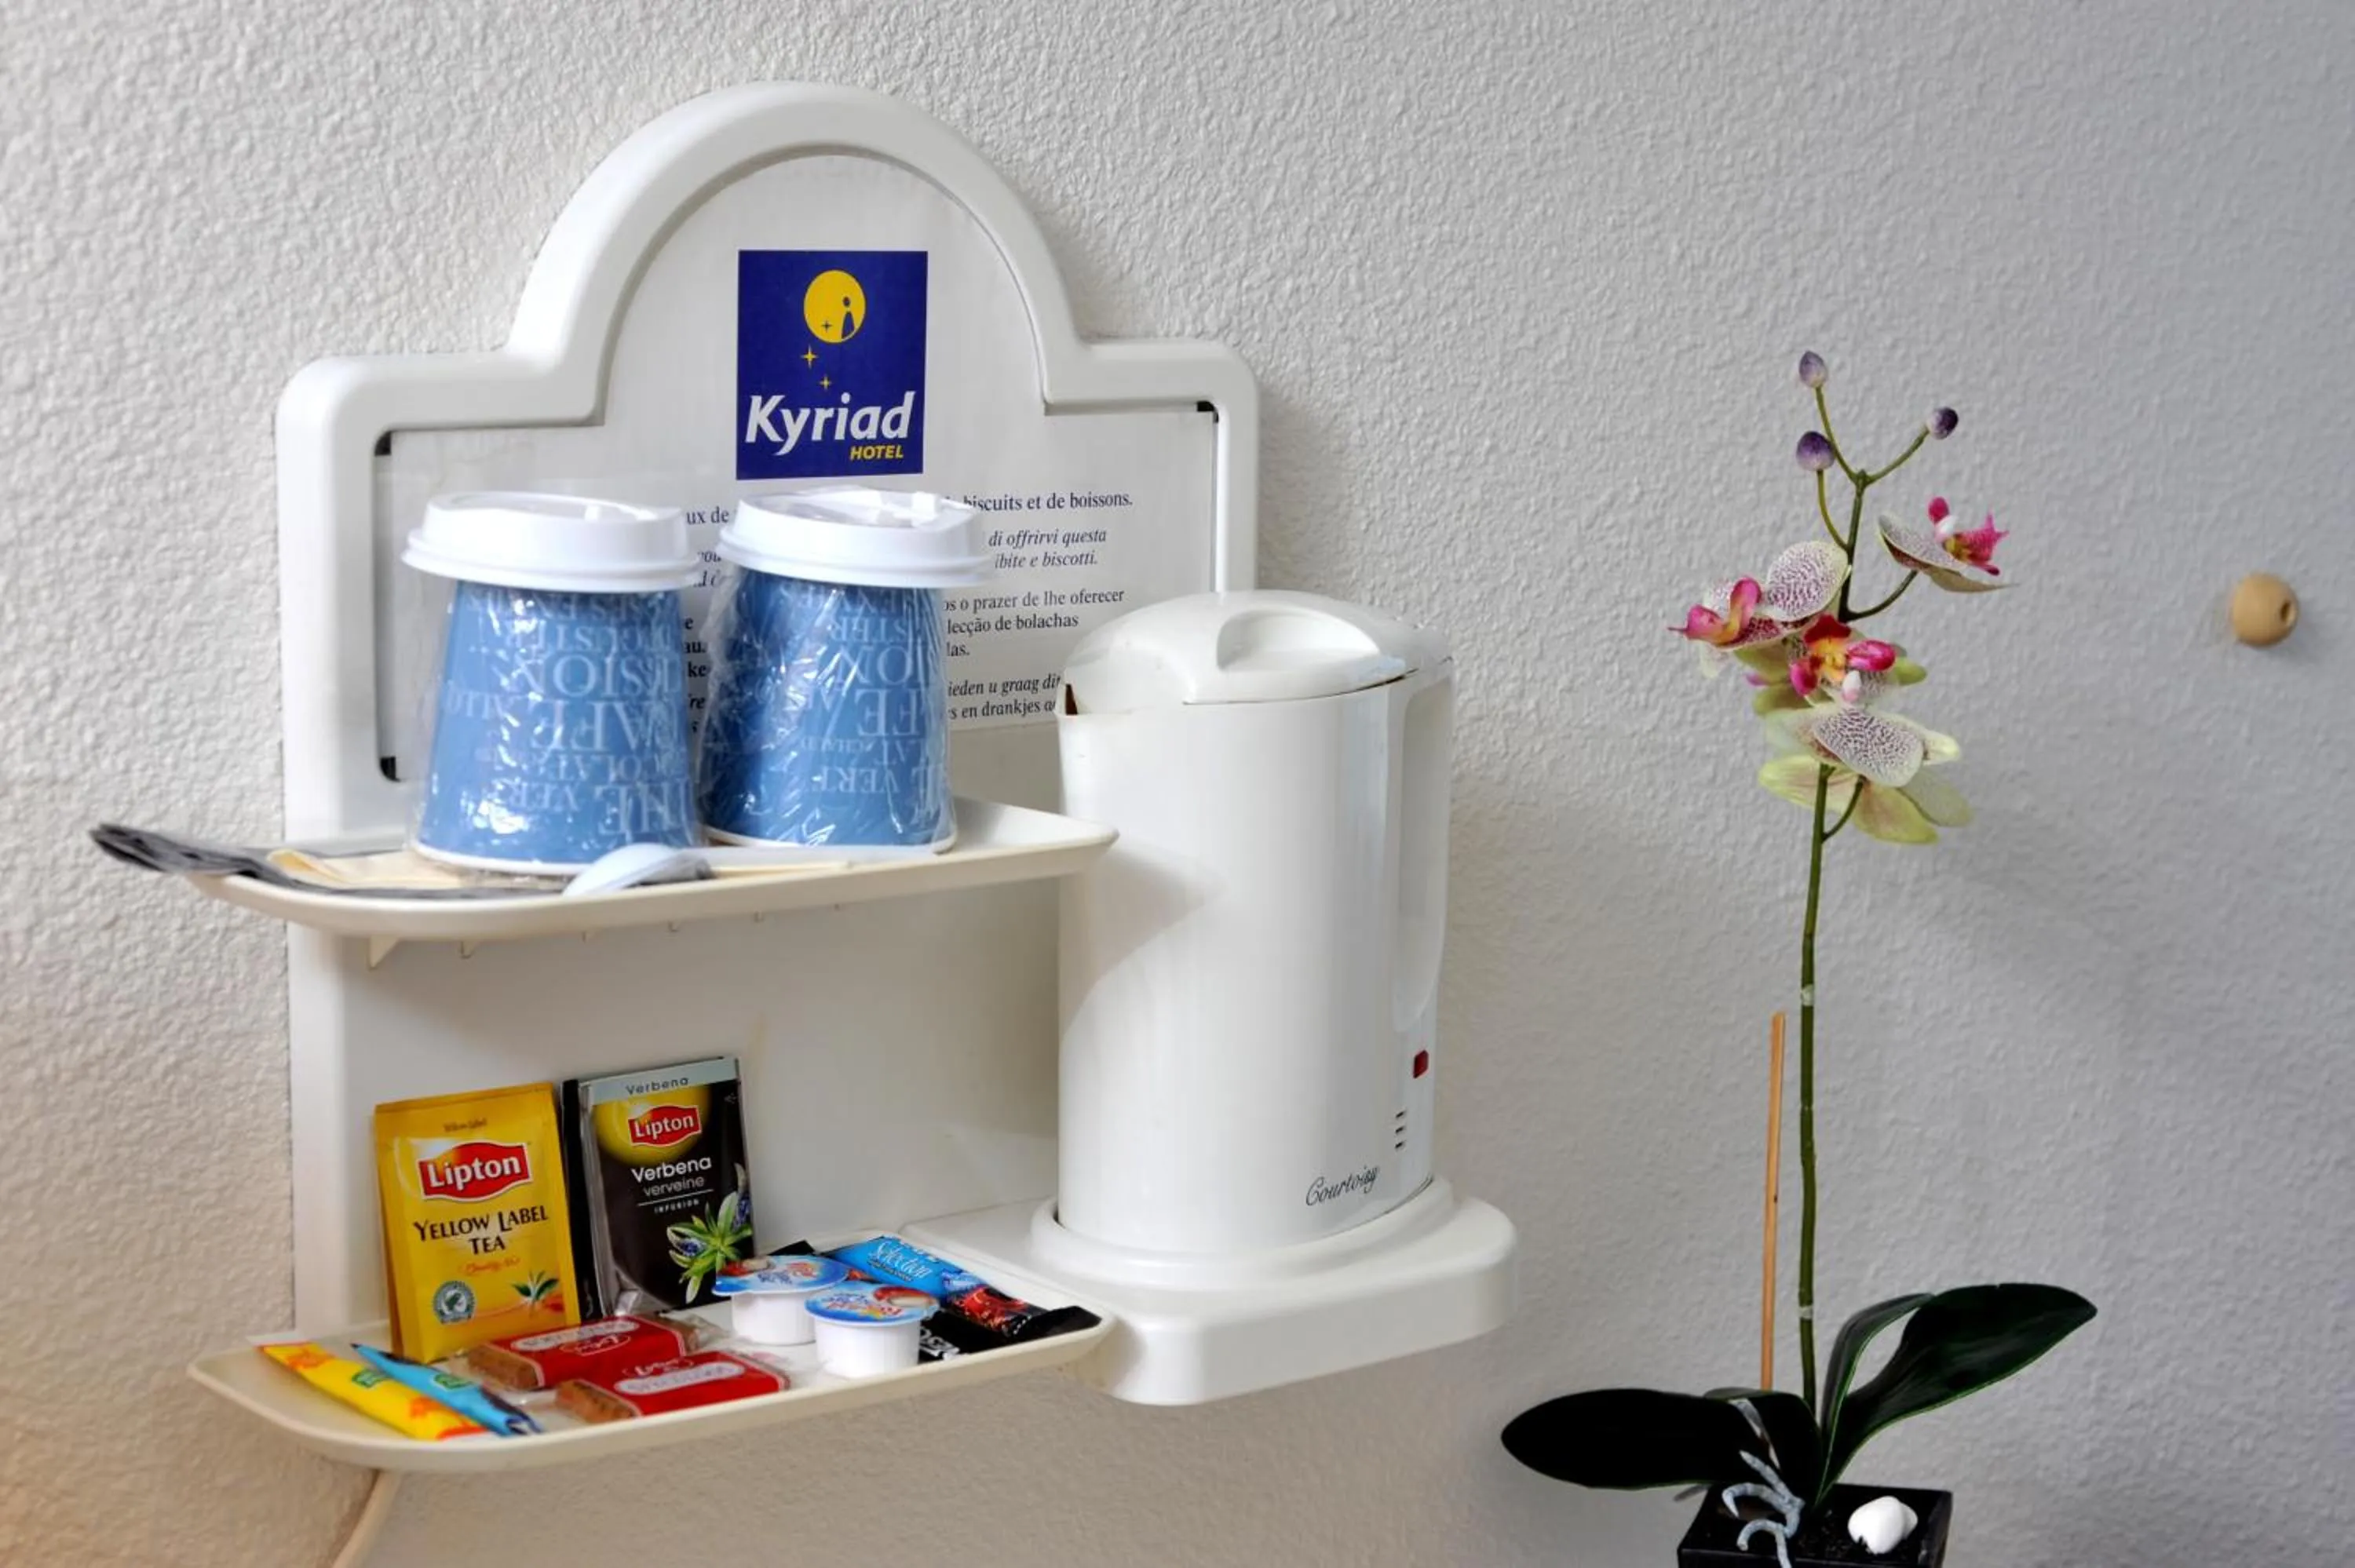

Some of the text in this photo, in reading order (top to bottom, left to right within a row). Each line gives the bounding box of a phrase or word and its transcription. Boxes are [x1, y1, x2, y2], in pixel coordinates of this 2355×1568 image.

[745, 391, 916, 457] Kyriad
[849, 445, 904, 461] HOTEL
[710, 505, 729, 523] de
[1027, 496, 1041, 509] et
[1046, 493, 1065, 509] de
[1070, 491, 1133, 509] boissons.
[988, 528, 1107, 549] di offrirvi questa
[1029, 556, 1039, 568] e
[1042, 550, 1098, 567] biscotti.
[960, 600, 969, 611] o
[973, 596, 1018, 614] prazer
[1022, 591, 1039, 607] de
[1044, 590, 1065, 607] lhe
[1070, 588, 1125, 605] oferecer
[947, 613, 1079, 637] lecção de bolachas
[988, 683, 998, 695] u
[1001, 678, 1039, 696] graag
[961, 706, 978, 719] en
[982, 698, 1040, 717] drankjes
[626, 1077, 689, 1095] Verbena
[634, 1115, 694, 1140] Lipton
[427, 1156, 521, 1191] Lipton
[630, 1157, 712, 1183] Verbena
[642, 1176, 706, 1197] verveine
[413, 1205, 549, 1242] YELLOW LABEL
[469, 1235, 506, 1255] TEA
